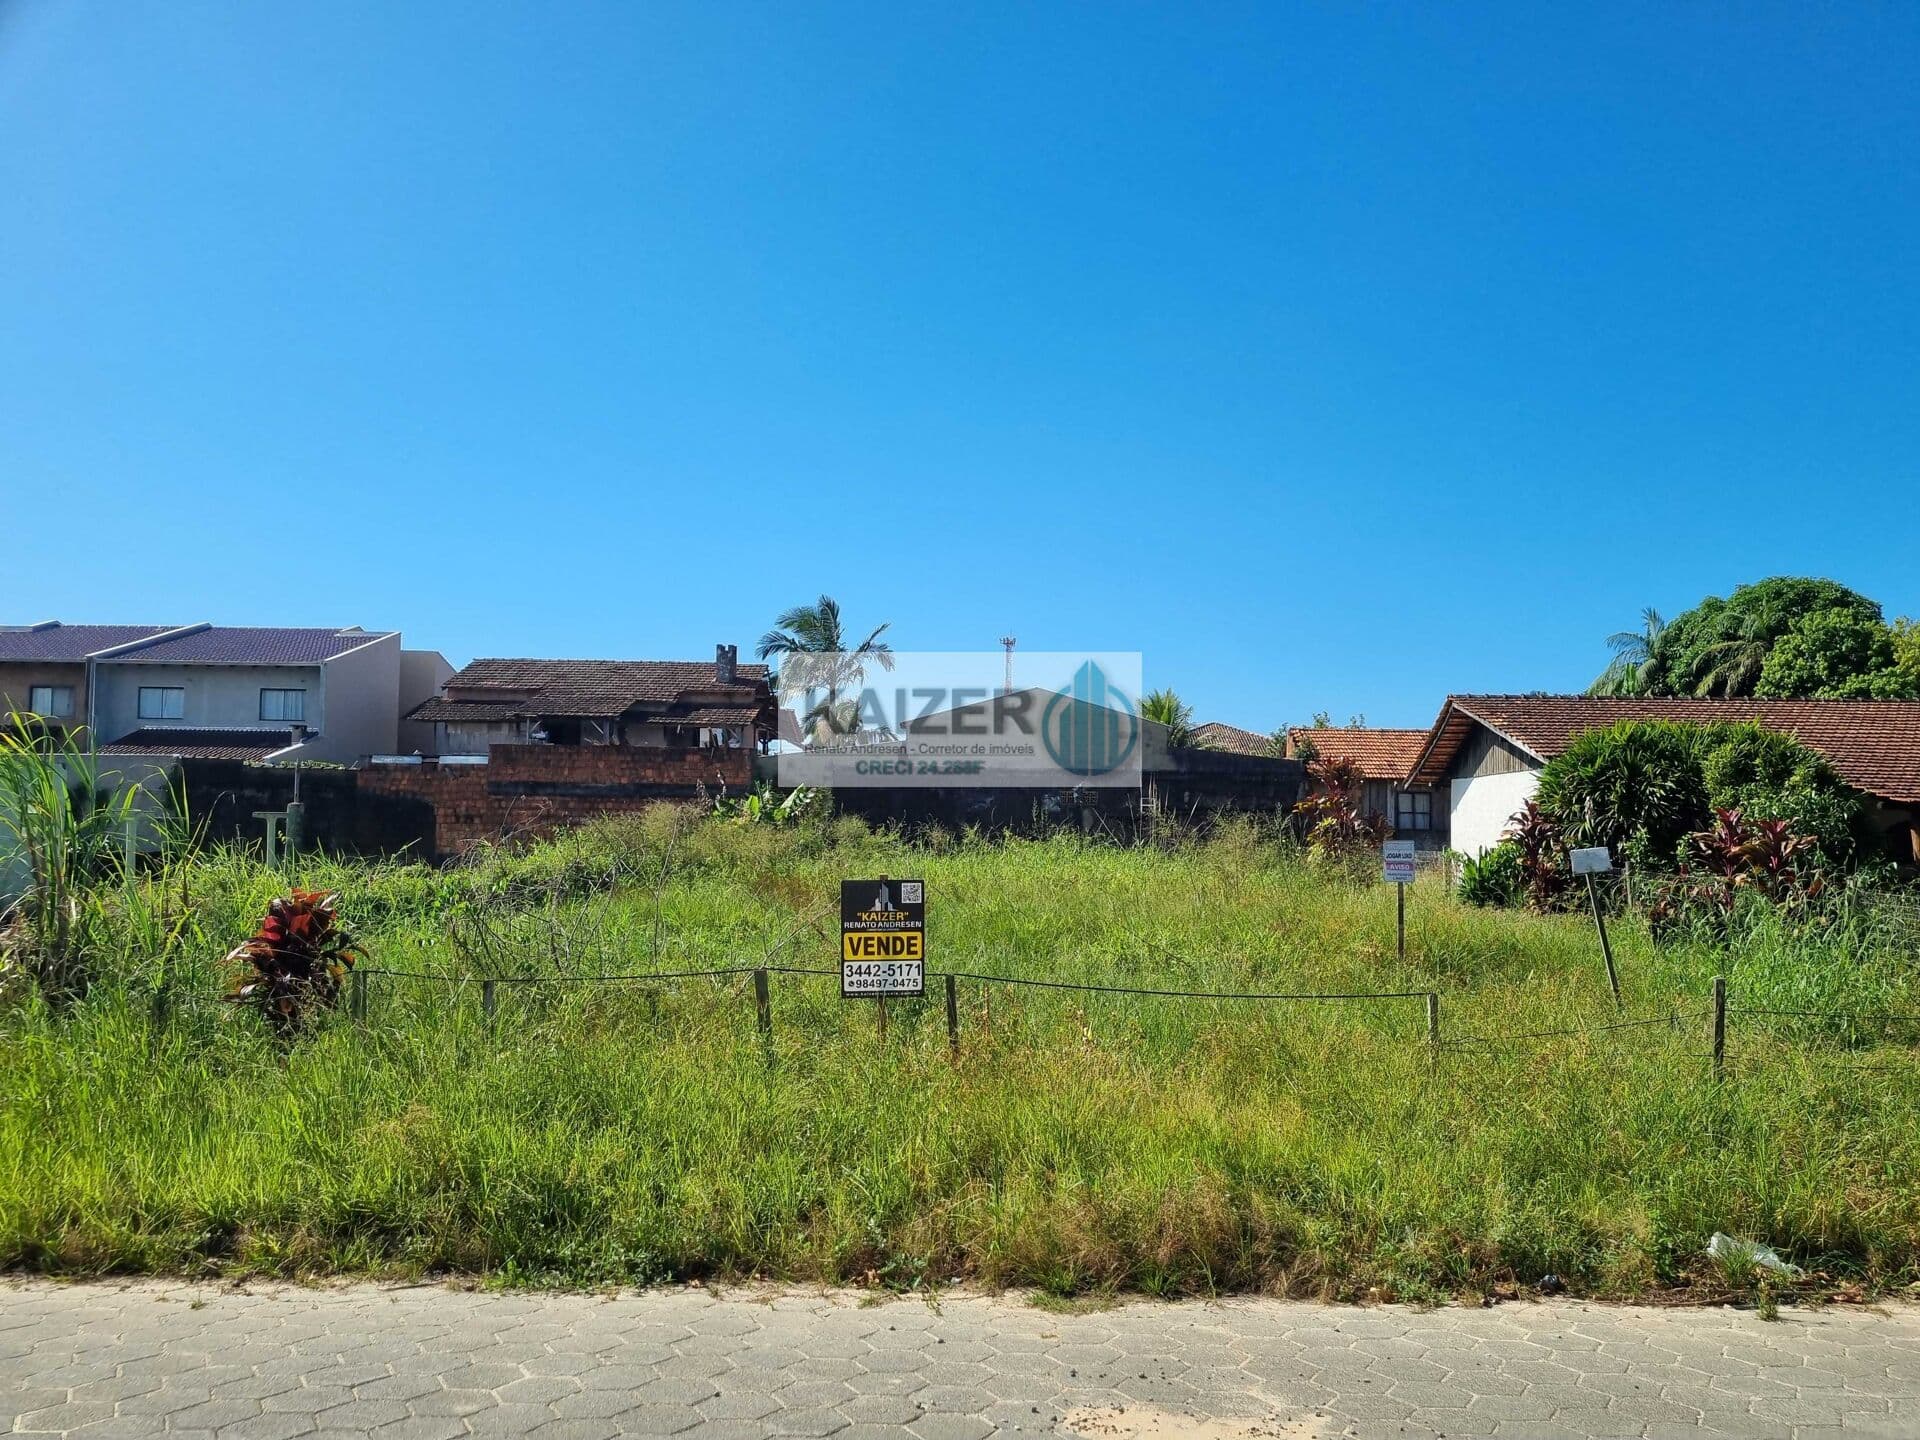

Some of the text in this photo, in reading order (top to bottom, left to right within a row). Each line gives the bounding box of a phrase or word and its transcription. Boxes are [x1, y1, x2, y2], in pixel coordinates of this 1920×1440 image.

[857, 912, 909, 921] "KAIZER"
[844, 921, 922, 929] RENATO ANDRESEN
[848, 936, 918, 956] VENDE
[846, 964, 921, 977] 3442-5171
[856, 979, 919, 988] 98497-0475
